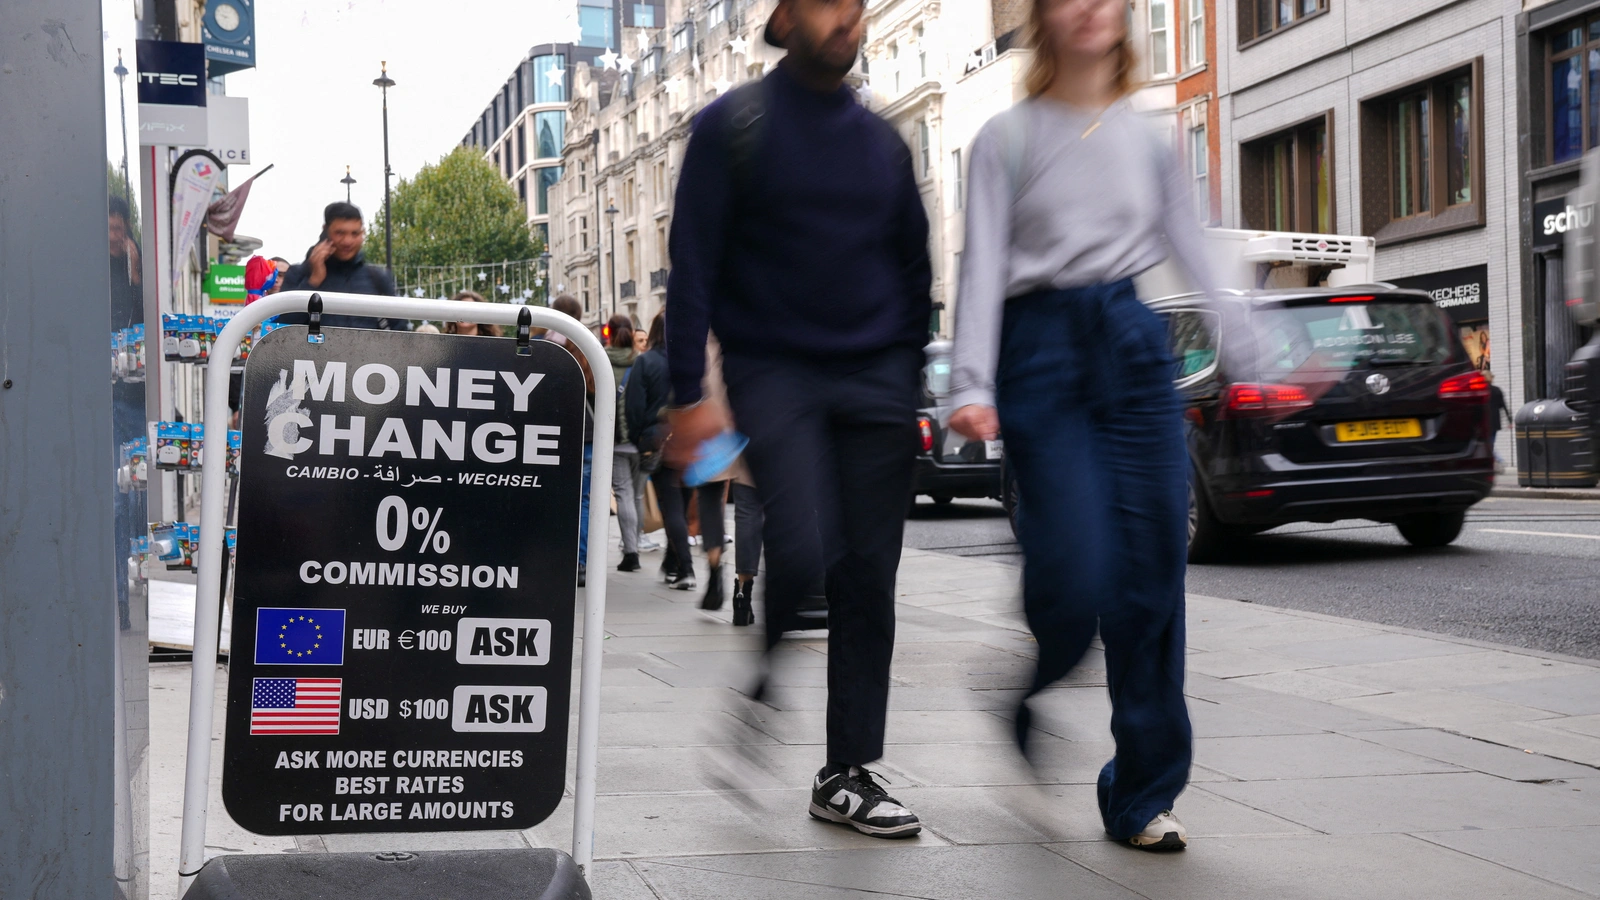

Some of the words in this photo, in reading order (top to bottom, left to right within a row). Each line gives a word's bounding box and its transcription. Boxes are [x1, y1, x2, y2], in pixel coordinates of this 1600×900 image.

[138, 72, 198, 86] ITEC
[1427, 282, 1480, 301] KECHERS
[1386, 333, 1416, 344] LEE
[293, 359, 546, 412] MONEY
[268, 412, 561, 466] CHANGE
[286, 465, 358, 480] CAMBIO
[458, 472, 542, 488] WECHSEL
[375, 495, 451, 554] 0%
[299, 560, 519, 589] COMMISSION
[421, 604, 440, 614] WE
[442, 604, 468, 615] BUY
[352, 628, 390, 650] EUR
[397, 629, 452, 651] €100
[469, 626, 540, 657] ASK
[348, 698, 389, 720] USD
[398, 698, 449, 720] $100
[464, 693, 535, 724] ASK
[274, 750, 320, 769] ASK
[326, 750, 387, 769] MORE
[392, 749, 524, 768] CURRENCIES
[335, 776, 390, 795] BEST
[396, 775, 465, 794] RATES
[279, 803, 324, 822] FOR
[330, 802, 403, 821] LARGE
[408, 800, 514, 820] AMOUNTS
